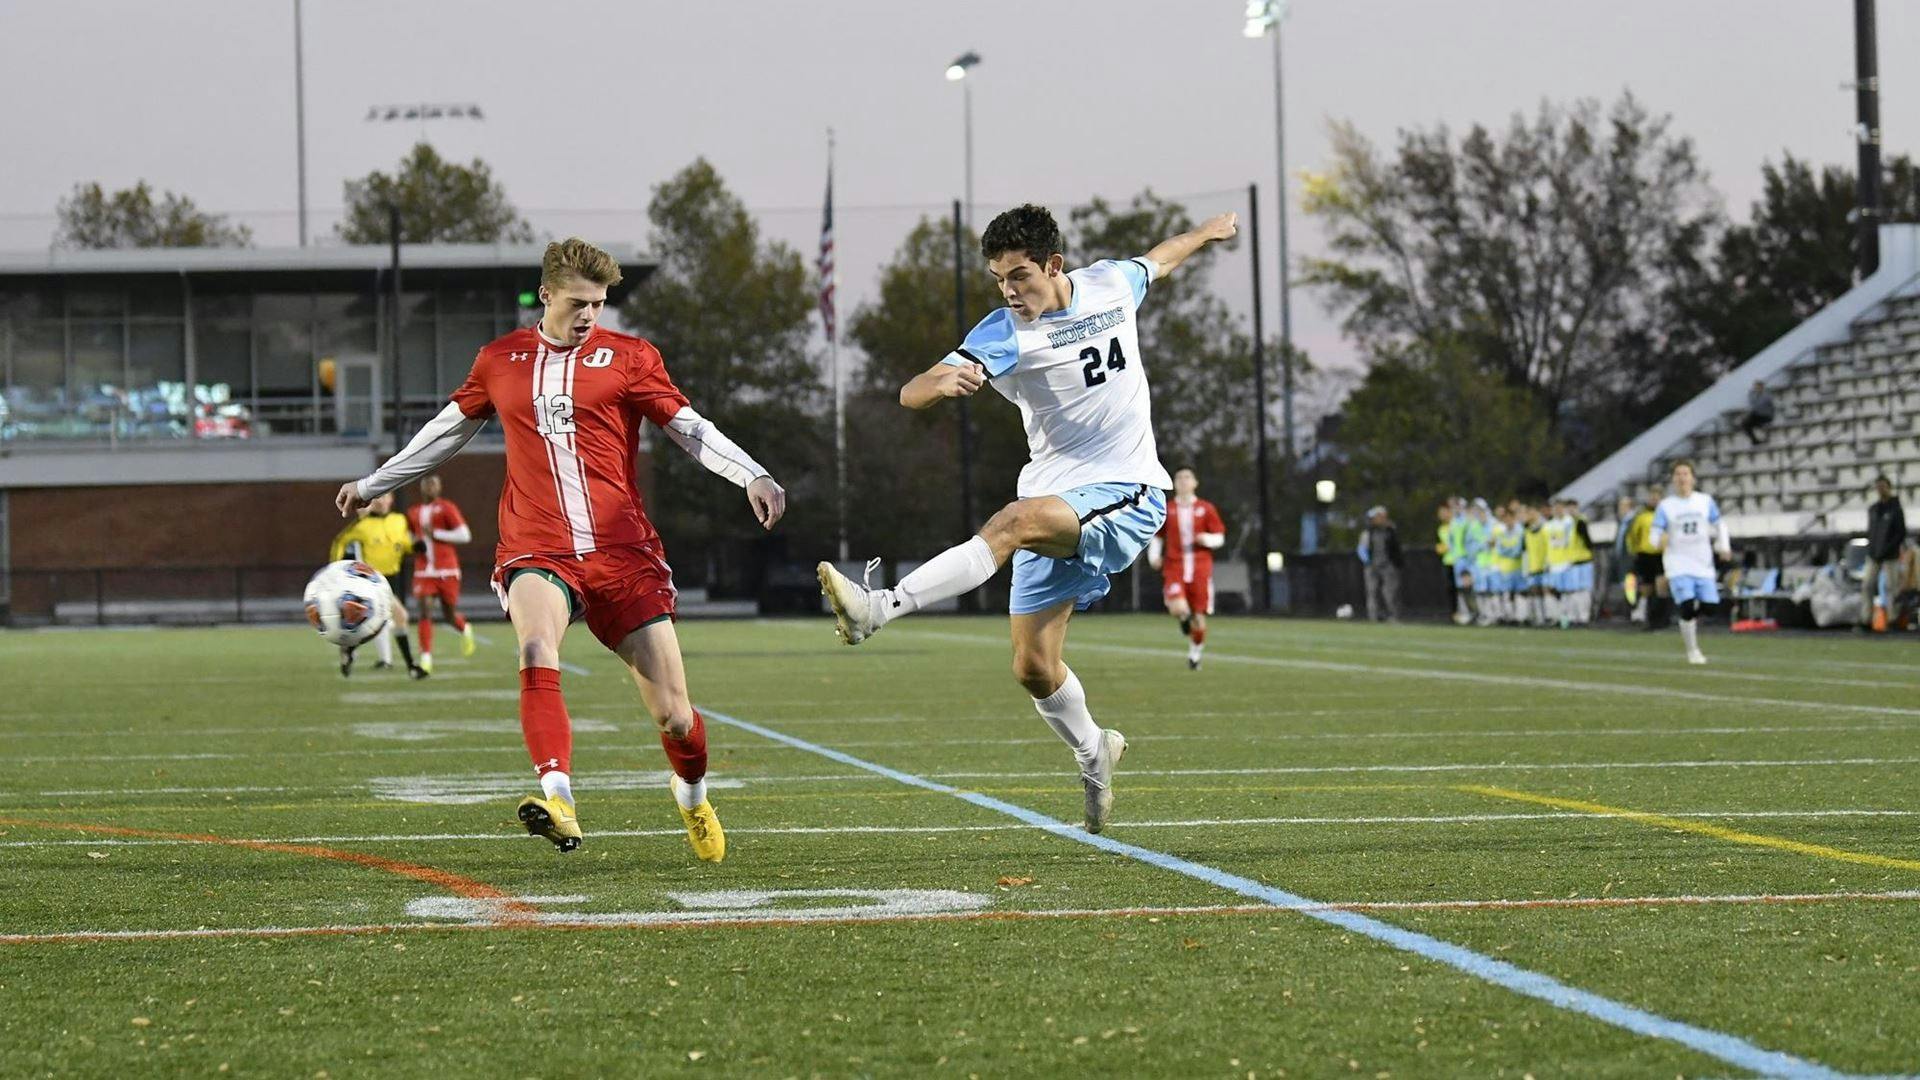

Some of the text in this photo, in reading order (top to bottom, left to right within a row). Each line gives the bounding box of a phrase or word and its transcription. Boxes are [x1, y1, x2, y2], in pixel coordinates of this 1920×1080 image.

[1047, 307, 1126, 349] HOPKINS
[1079, 337, 1126, 387] 24
[533, 394, 577, 434] 12
